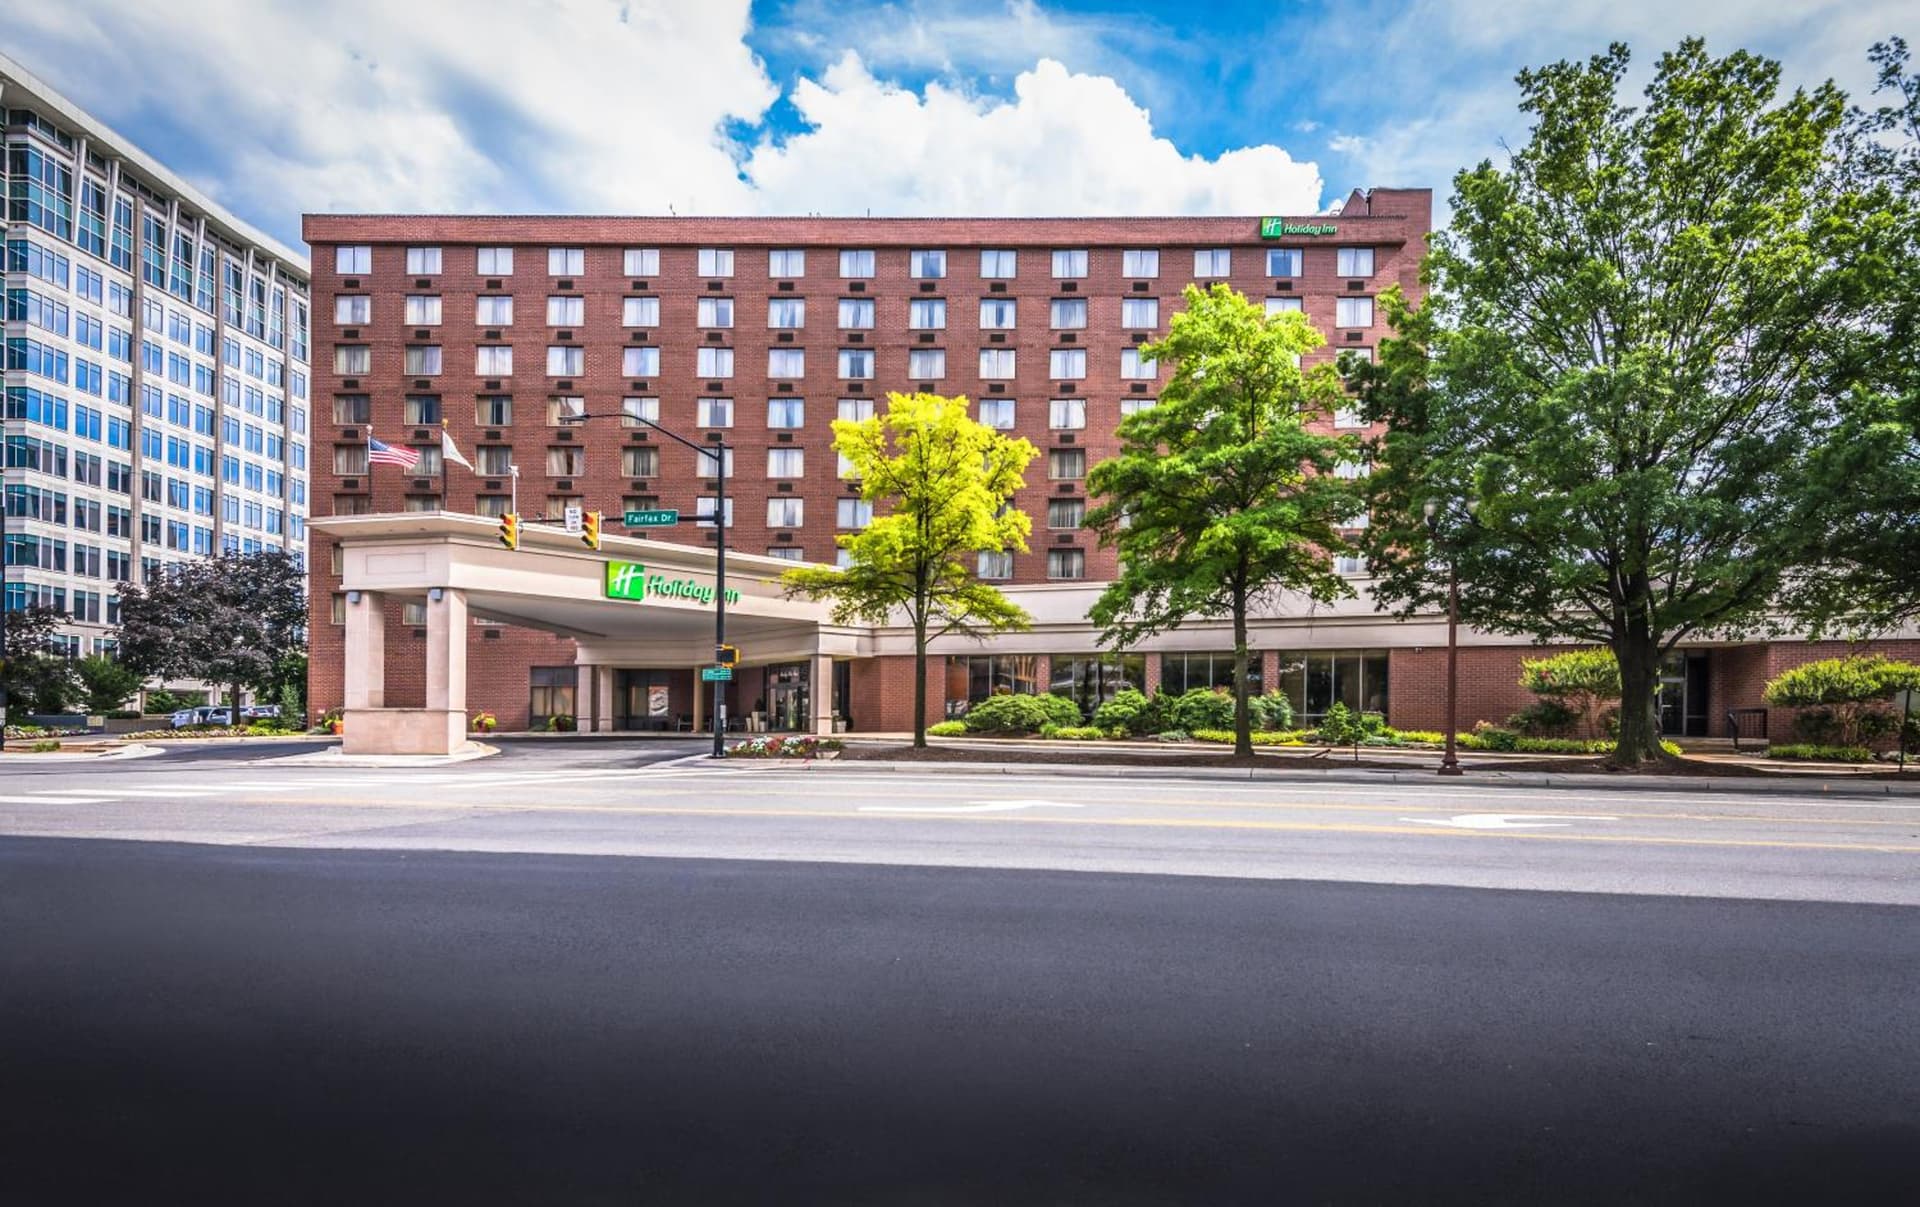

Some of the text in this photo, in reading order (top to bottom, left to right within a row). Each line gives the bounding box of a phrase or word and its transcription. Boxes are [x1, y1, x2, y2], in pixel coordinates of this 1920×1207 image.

[1284, 223, 1321, 236] Holiday
[1322, 223, 1338, 234] Inn
[628, 514, 659, 524] Fairfax
[648, 576, 713, 604] Holiday
